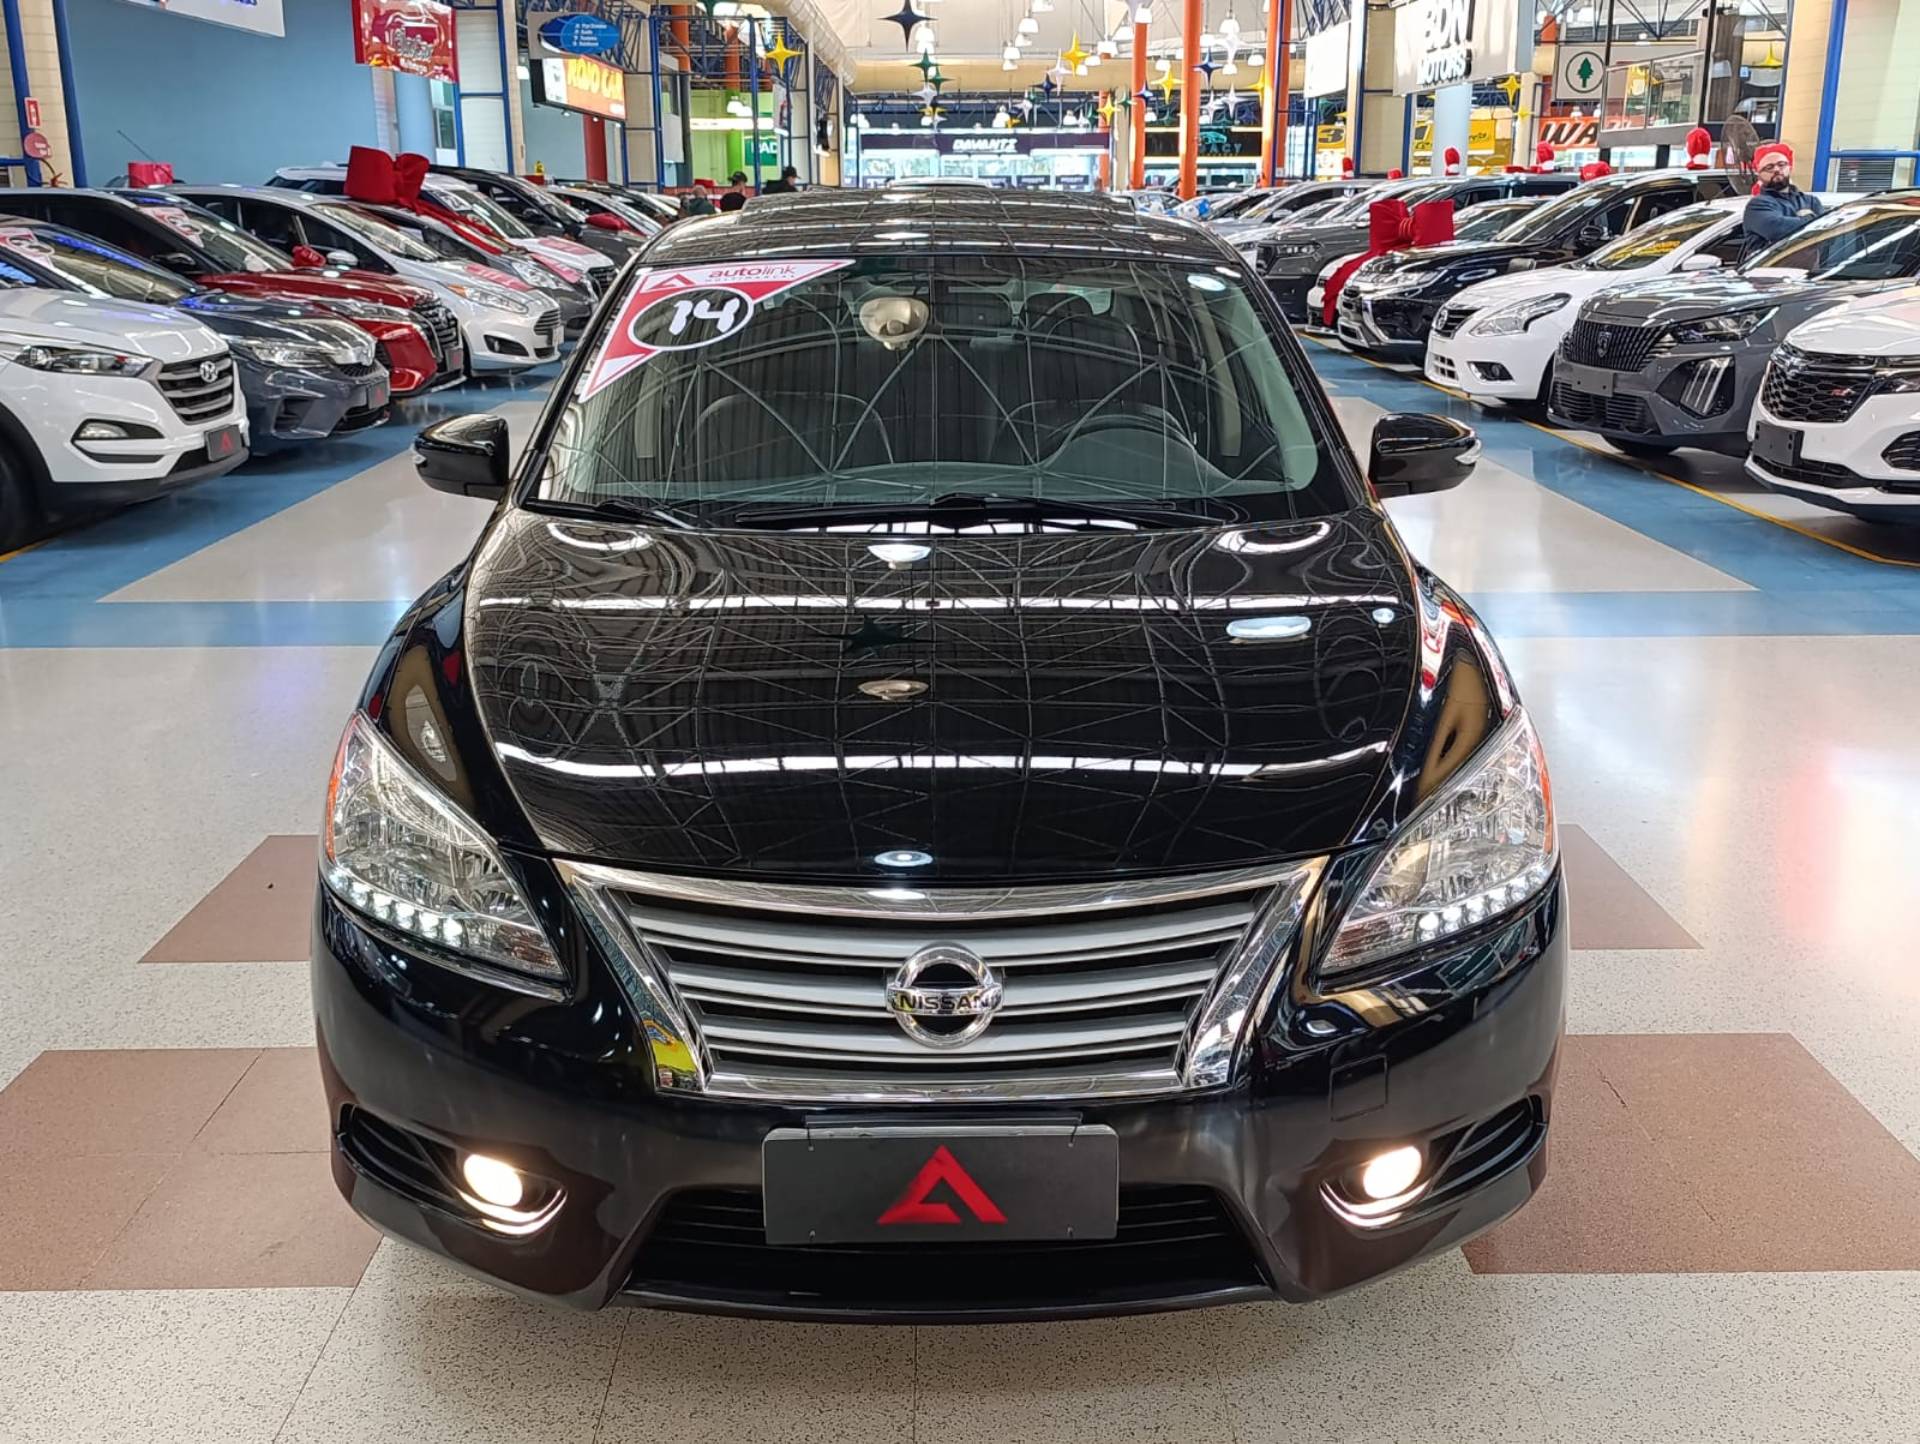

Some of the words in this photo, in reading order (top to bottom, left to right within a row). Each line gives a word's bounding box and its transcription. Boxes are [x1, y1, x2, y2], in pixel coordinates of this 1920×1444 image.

[708, 265, 796, 278] autolink
[669, 297, 741, 336] 14
[900, 994, 990, 1010] NISSAN
